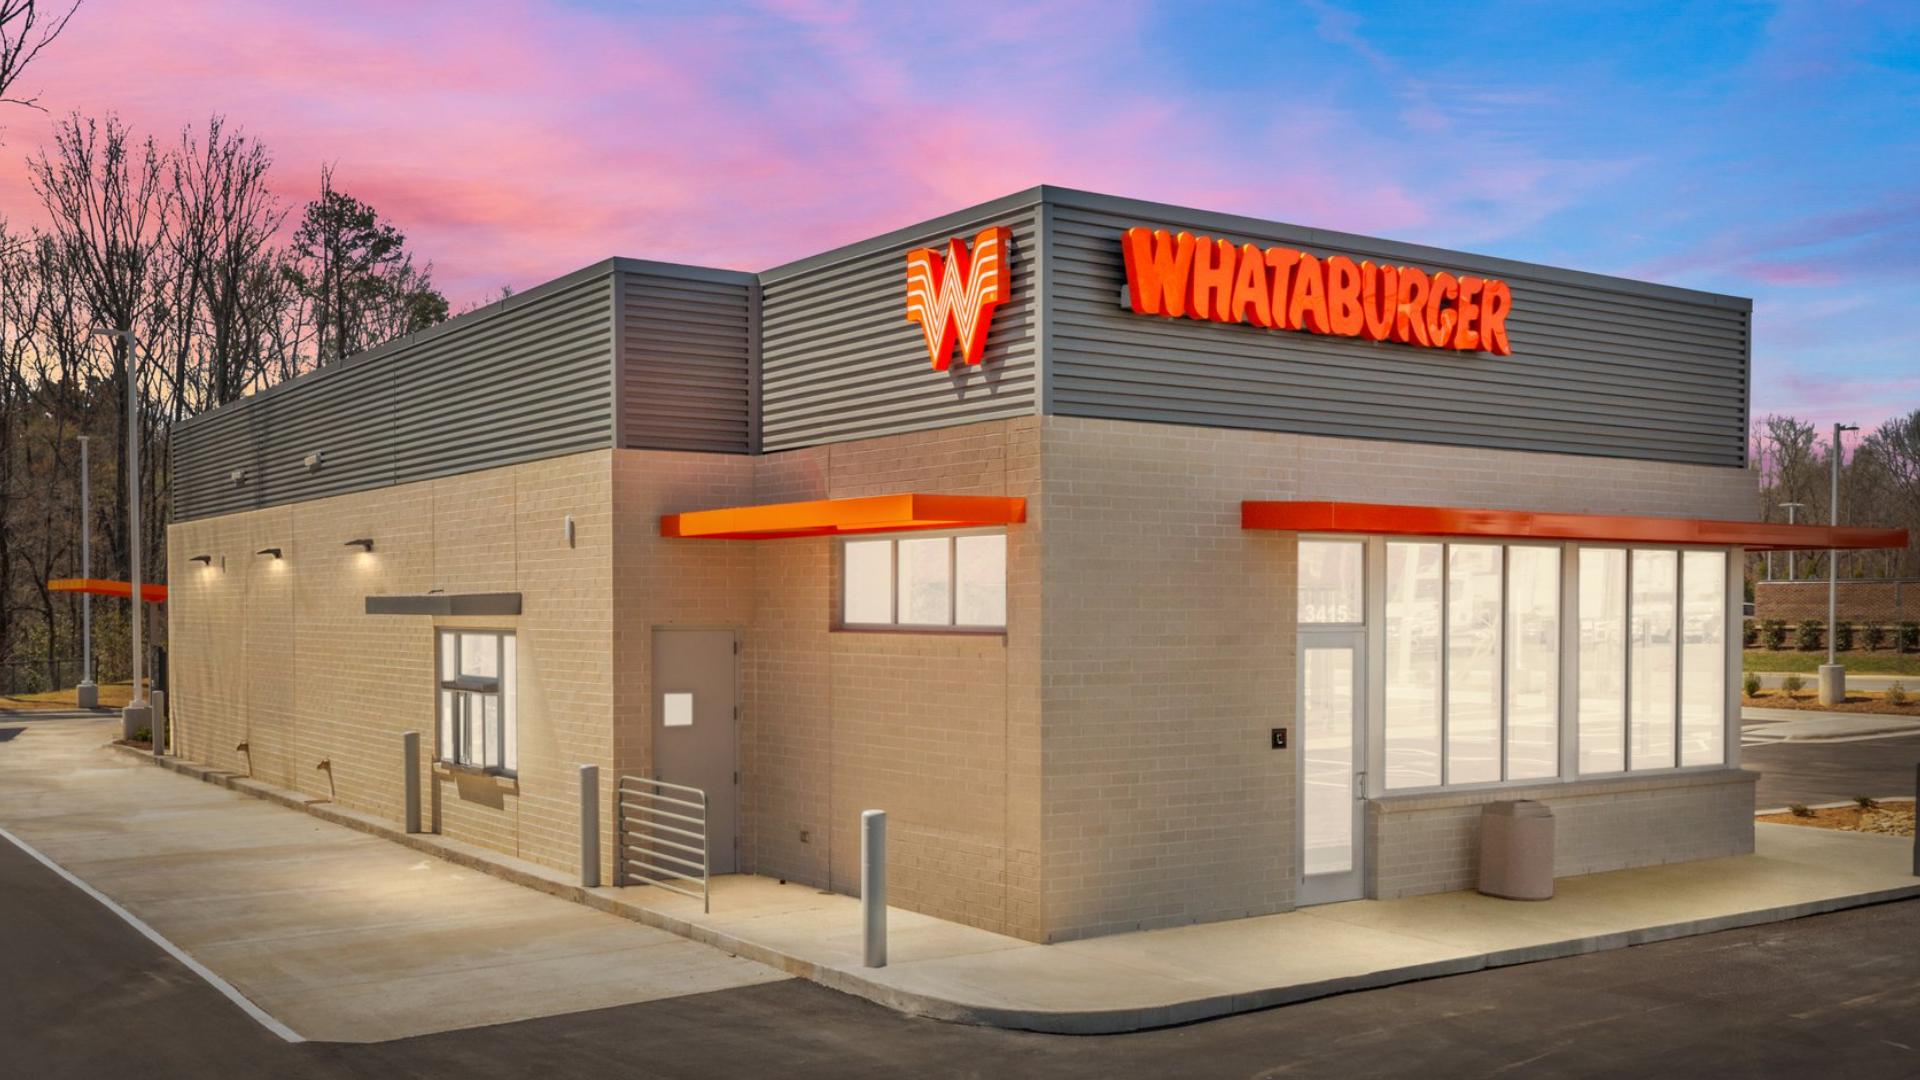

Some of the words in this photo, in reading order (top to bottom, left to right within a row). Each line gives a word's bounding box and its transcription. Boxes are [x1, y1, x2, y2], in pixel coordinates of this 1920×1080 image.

[906, 227, 1012, 371] W
[1122, 227, 1512, 356] WHATABURGER
[1305, 604, 1348, 622] 3415
